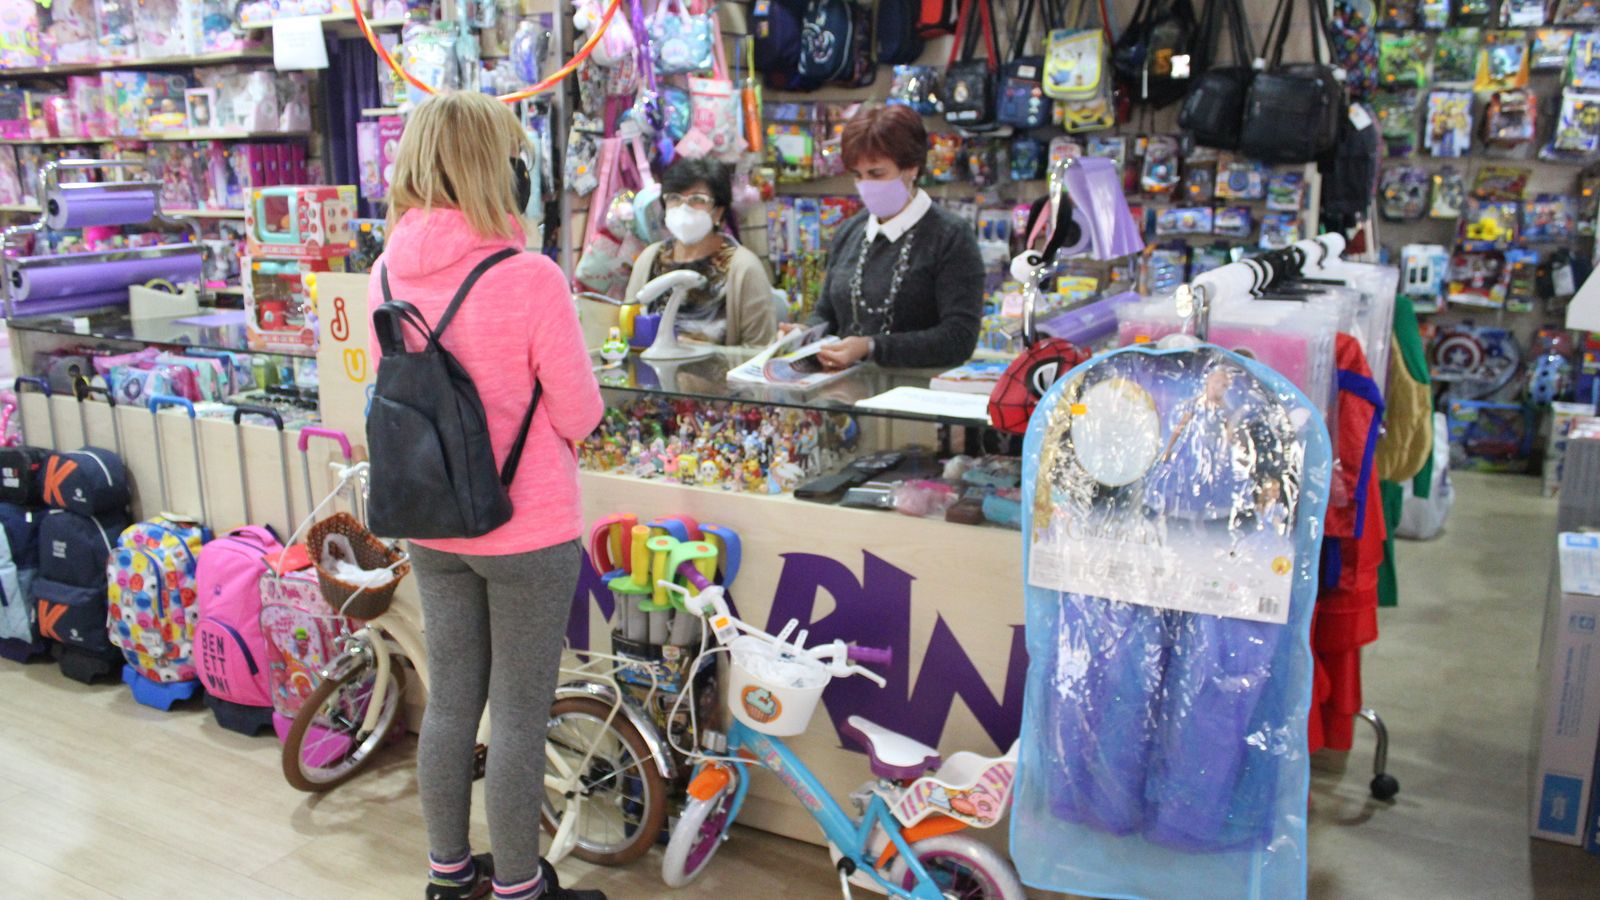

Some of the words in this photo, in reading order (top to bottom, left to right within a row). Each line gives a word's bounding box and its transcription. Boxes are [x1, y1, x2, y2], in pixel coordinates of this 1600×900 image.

[43, 454, 78, 507] K
[38, 599, 69, 643] K
[202, 629, 225, 656] BEN
[203, 652, 226, 676] ETT
